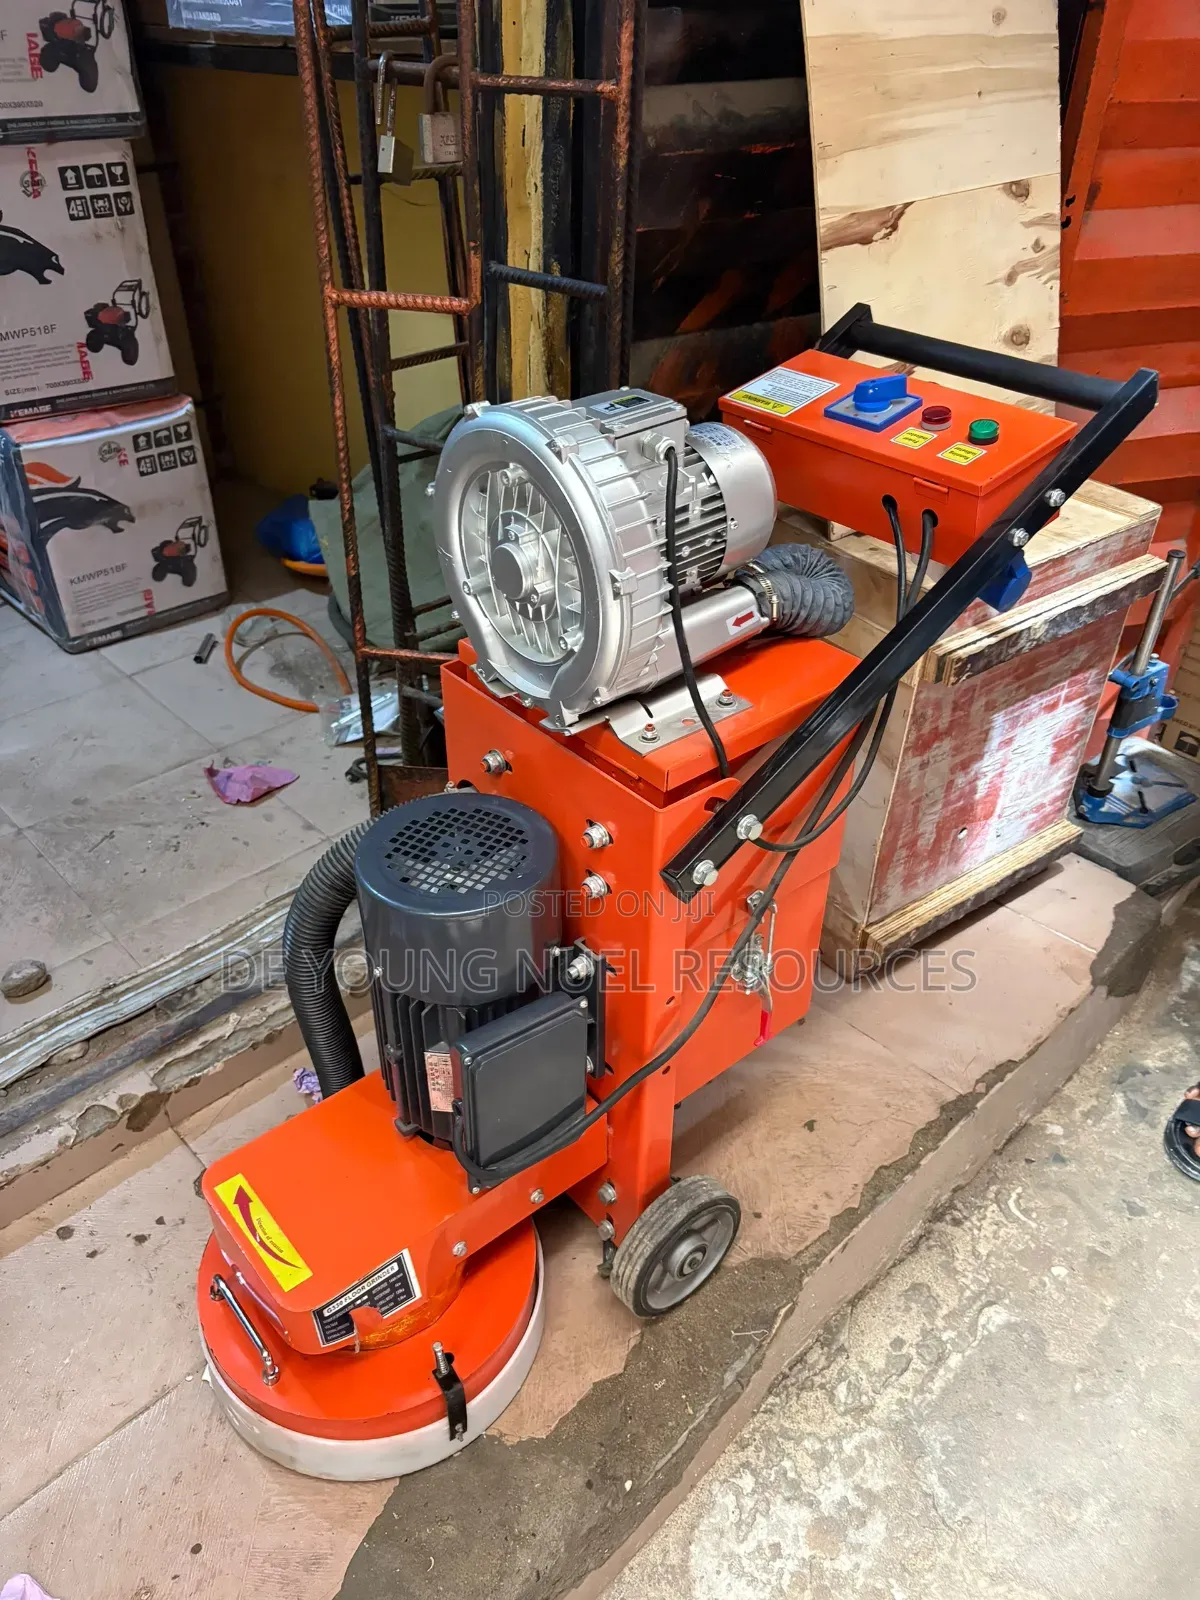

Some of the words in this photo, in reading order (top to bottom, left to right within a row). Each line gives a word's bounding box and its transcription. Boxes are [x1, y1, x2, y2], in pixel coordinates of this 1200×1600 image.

[69, 563, 128, 586] KMWP518F
[344, 1286, 366, 1303] FLOOR
[366, 1264, 396, 1288] GRINDER
